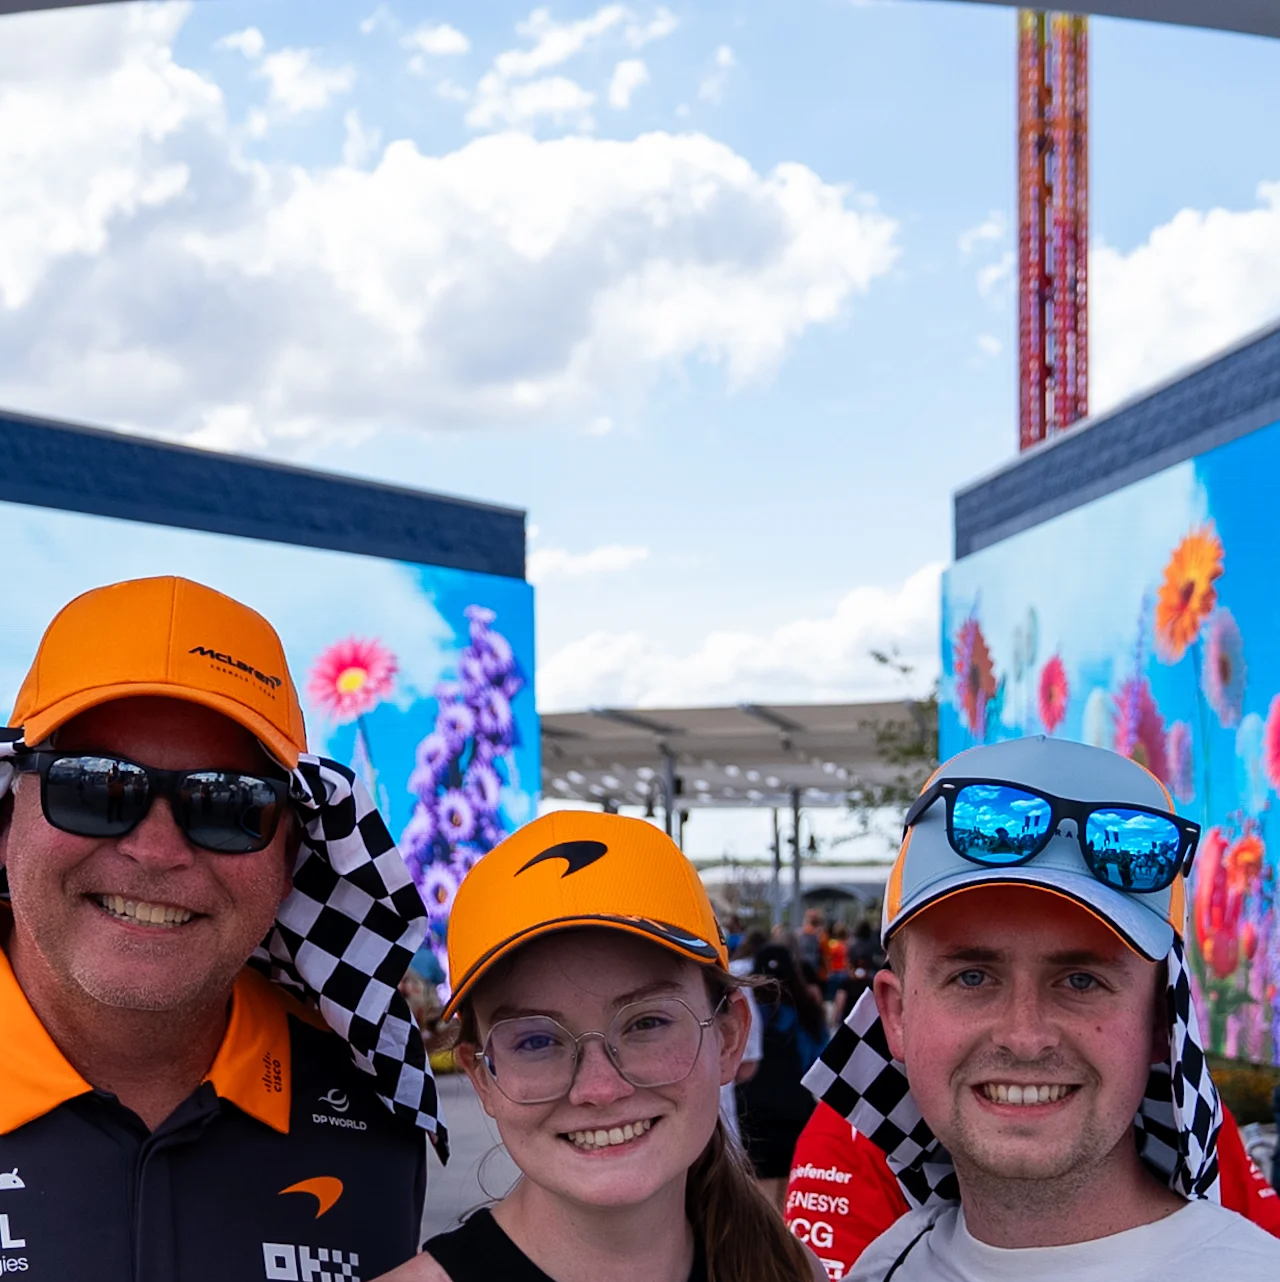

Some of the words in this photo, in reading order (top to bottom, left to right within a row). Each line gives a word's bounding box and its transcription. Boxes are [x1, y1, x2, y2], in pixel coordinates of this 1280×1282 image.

[188, 646, 277, 690] McLaren
[272, 1059, 282, 1093] cisco
[312, 1113, 328, 1124] DP
[328, 1115, 368, 1131] WORLD
